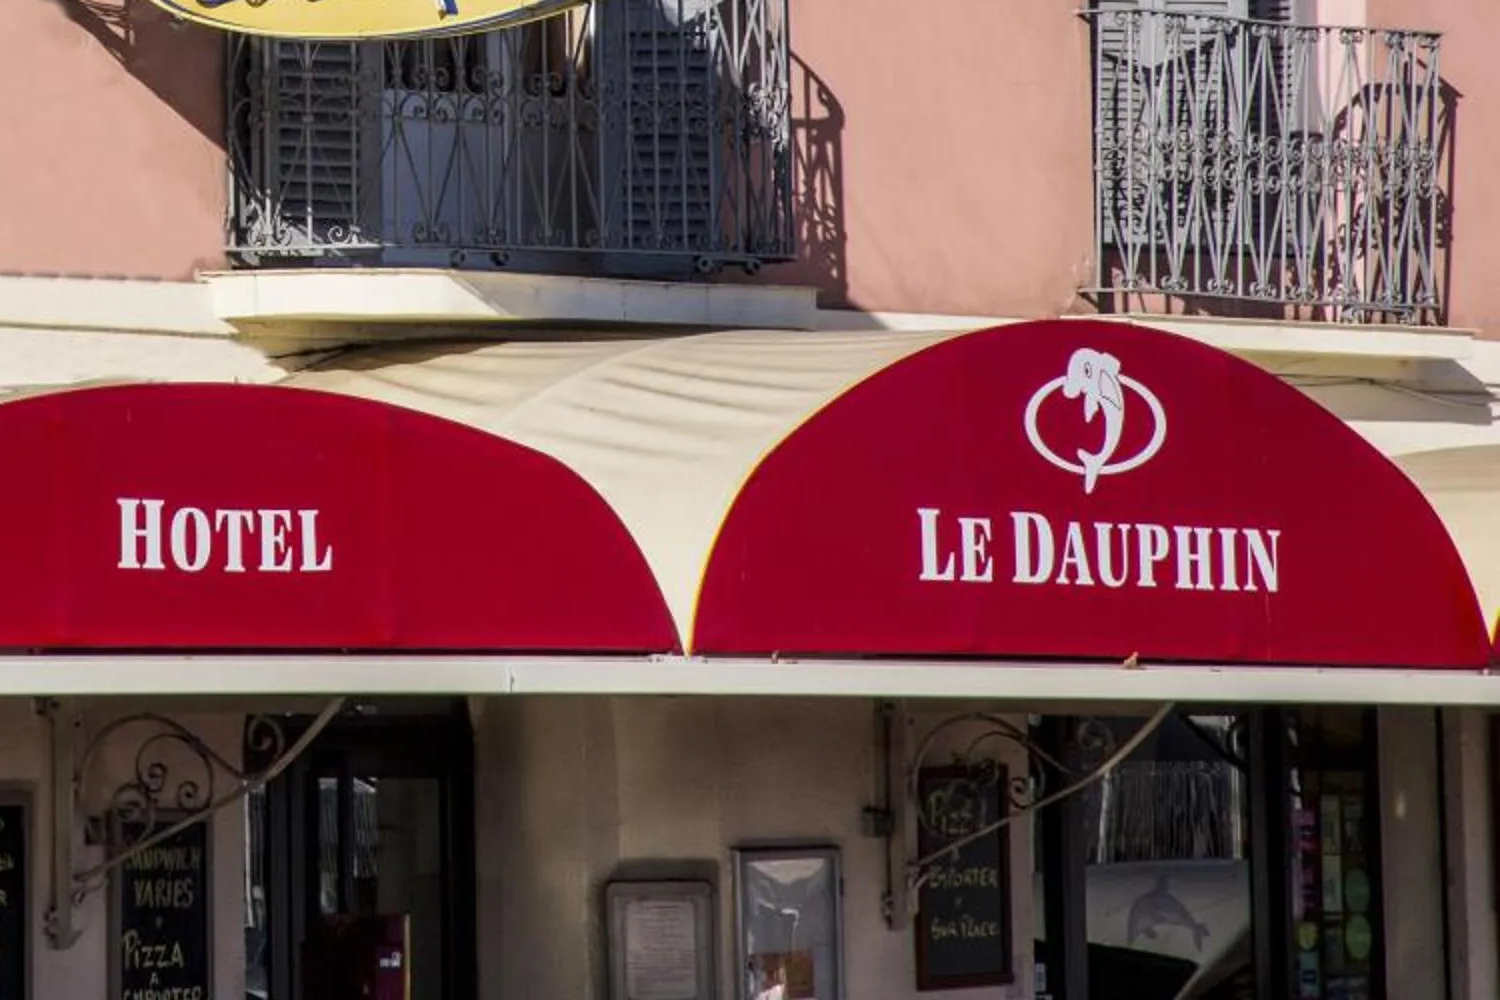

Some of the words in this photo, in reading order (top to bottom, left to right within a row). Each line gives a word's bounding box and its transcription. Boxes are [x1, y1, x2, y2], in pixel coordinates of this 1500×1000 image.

[116, 498, 333, 573] HOTEL
[917, 508, 994, 583] LE
[1010, 511, 1281, 593] DAUPHIN
